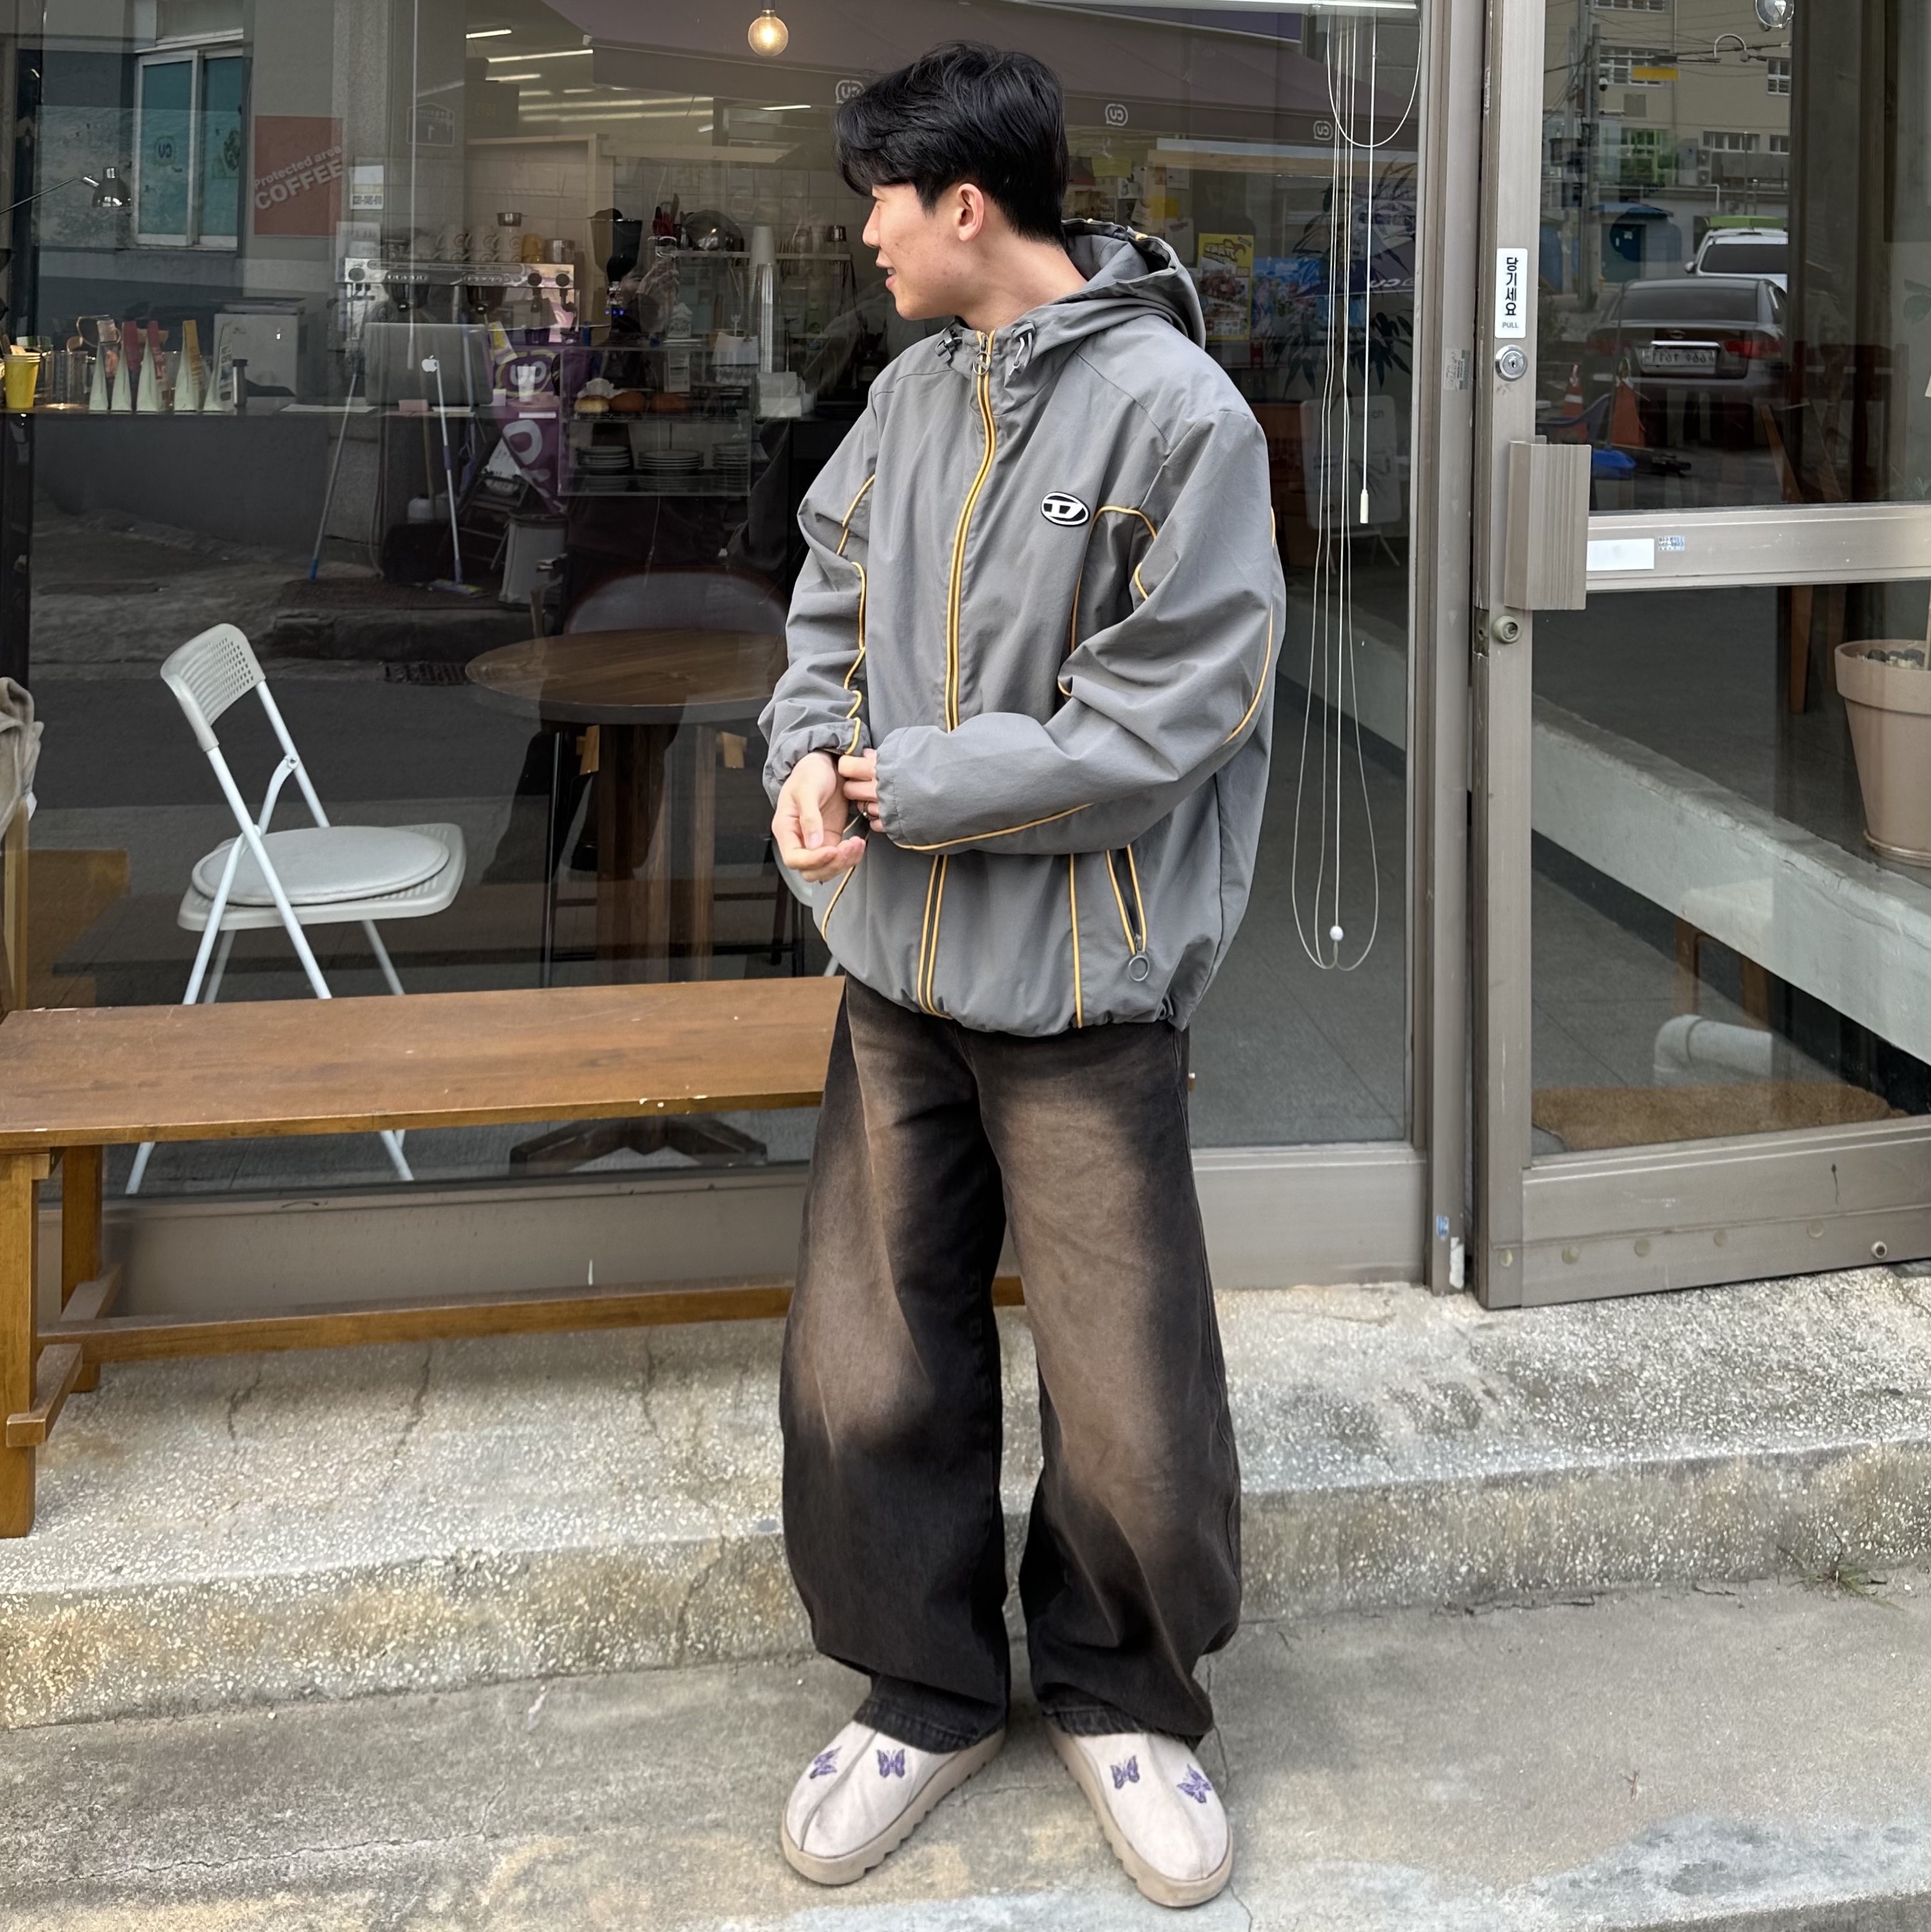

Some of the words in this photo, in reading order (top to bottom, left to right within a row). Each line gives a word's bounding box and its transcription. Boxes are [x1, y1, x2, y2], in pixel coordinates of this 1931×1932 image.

[255, 155, 313, 189] Protected
[313, 145, 342, 163] area
[255, 159, 343, 210] COFFEE
[1505, 256, 1519, 316] 당기세요
